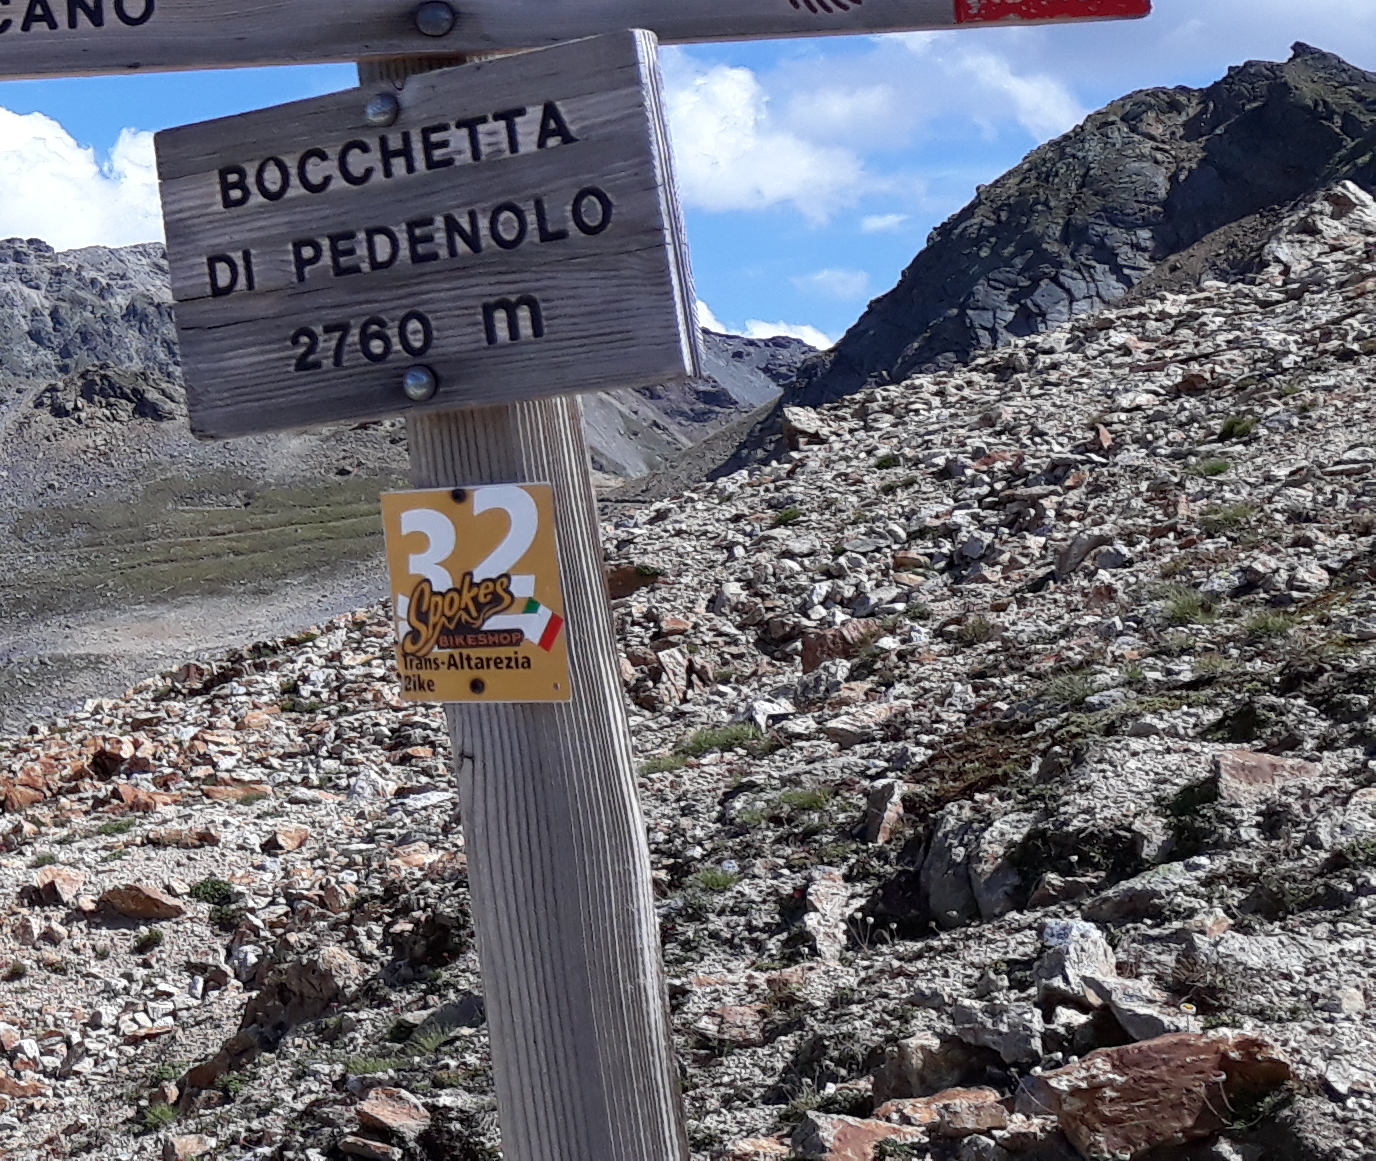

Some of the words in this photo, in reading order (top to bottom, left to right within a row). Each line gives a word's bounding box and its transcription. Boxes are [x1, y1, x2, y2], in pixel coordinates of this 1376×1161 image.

[217, 100, 579, 209] BOCCHETTA
[206, 249, 255, 297] DI
[292, 185, 614, 283] PEDENOLO
[290, 309, 434, 373] 2760
[482, 294, 545, 346] m
[398, 484, 538, 623] 32
[402, 573, 513, 656] Spokes
[438, 632, 522, 647] BIKESHOP
